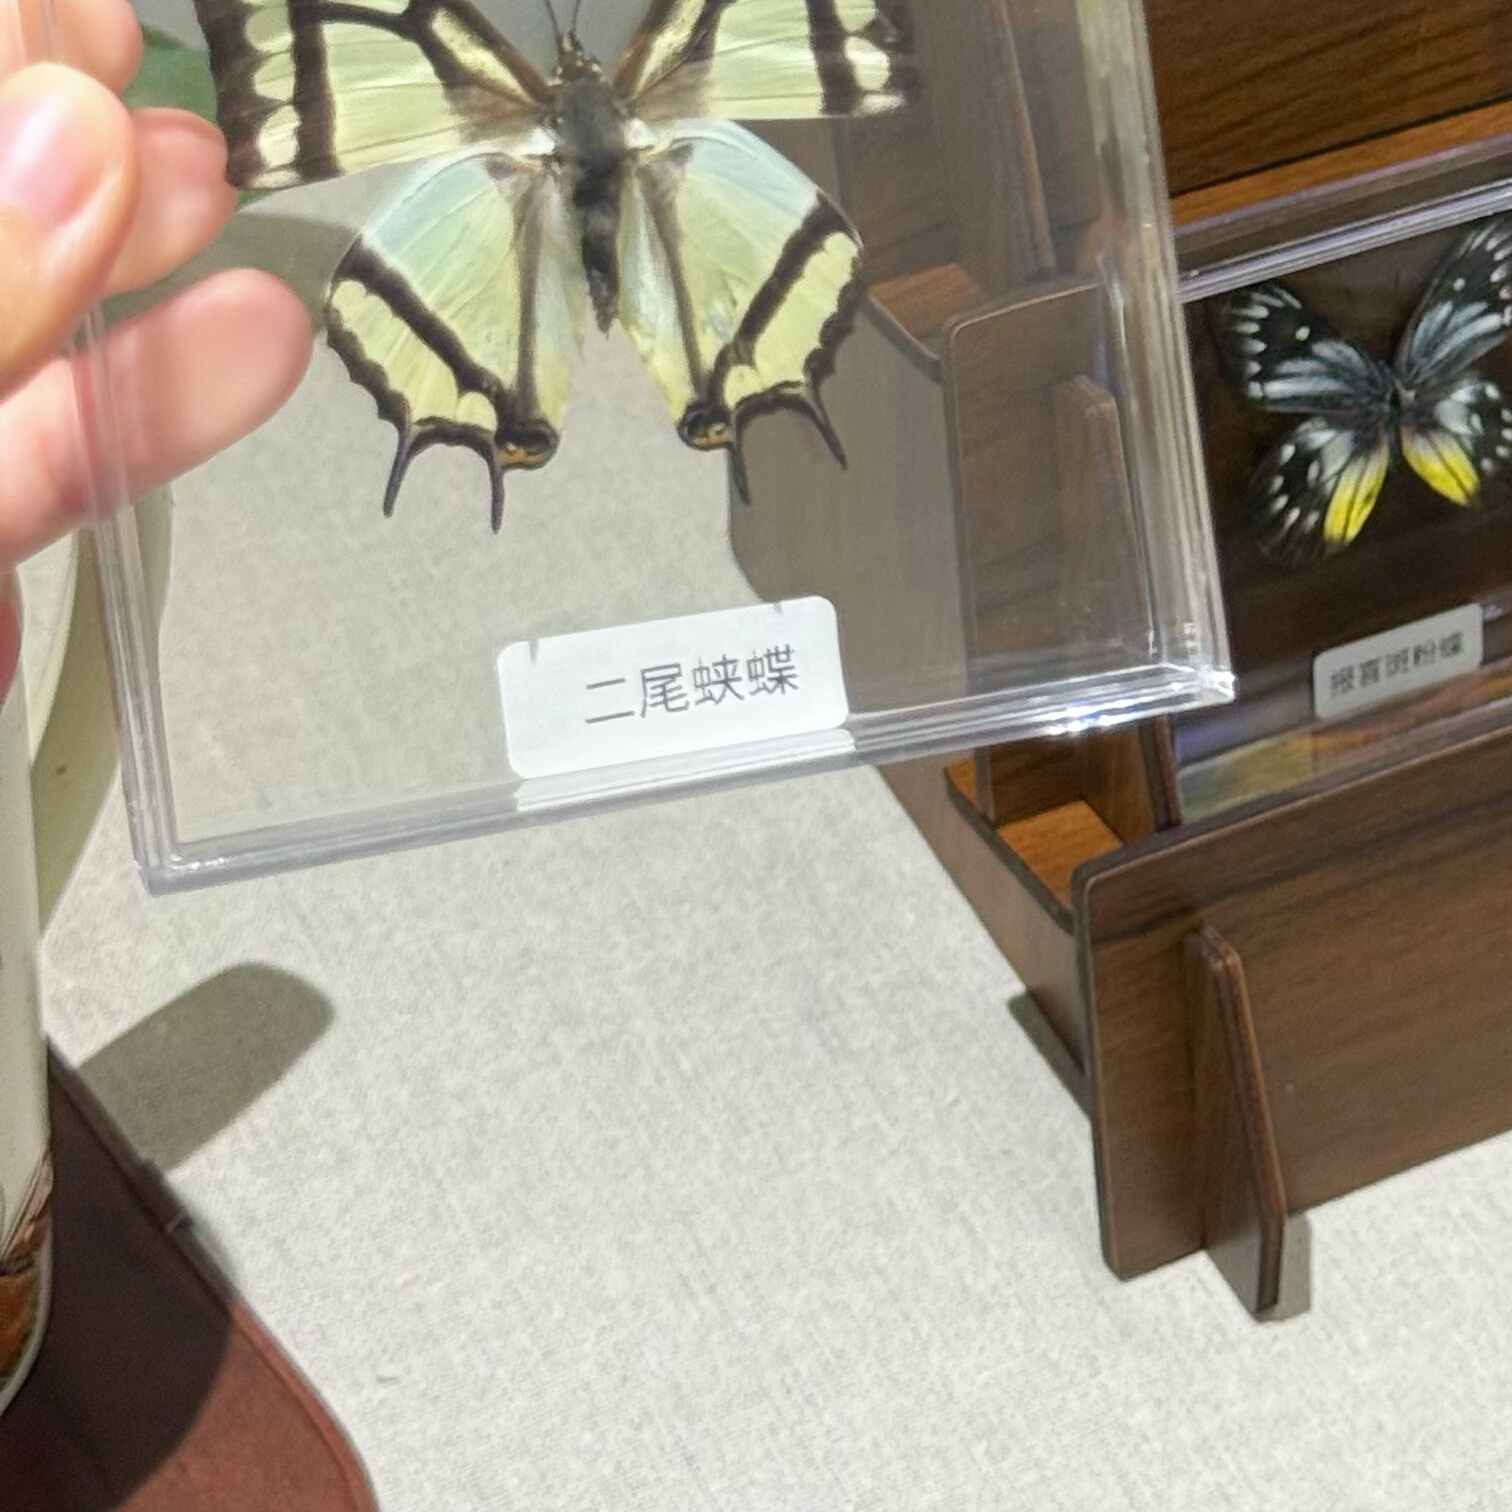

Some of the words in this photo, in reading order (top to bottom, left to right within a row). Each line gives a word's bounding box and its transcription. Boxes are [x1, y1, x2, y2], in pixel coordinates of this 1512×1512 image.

[584, 642, 800, 727] 二尾蛱蝶
[1329, 630, 1464, 698] 报喜斑粉蝶
